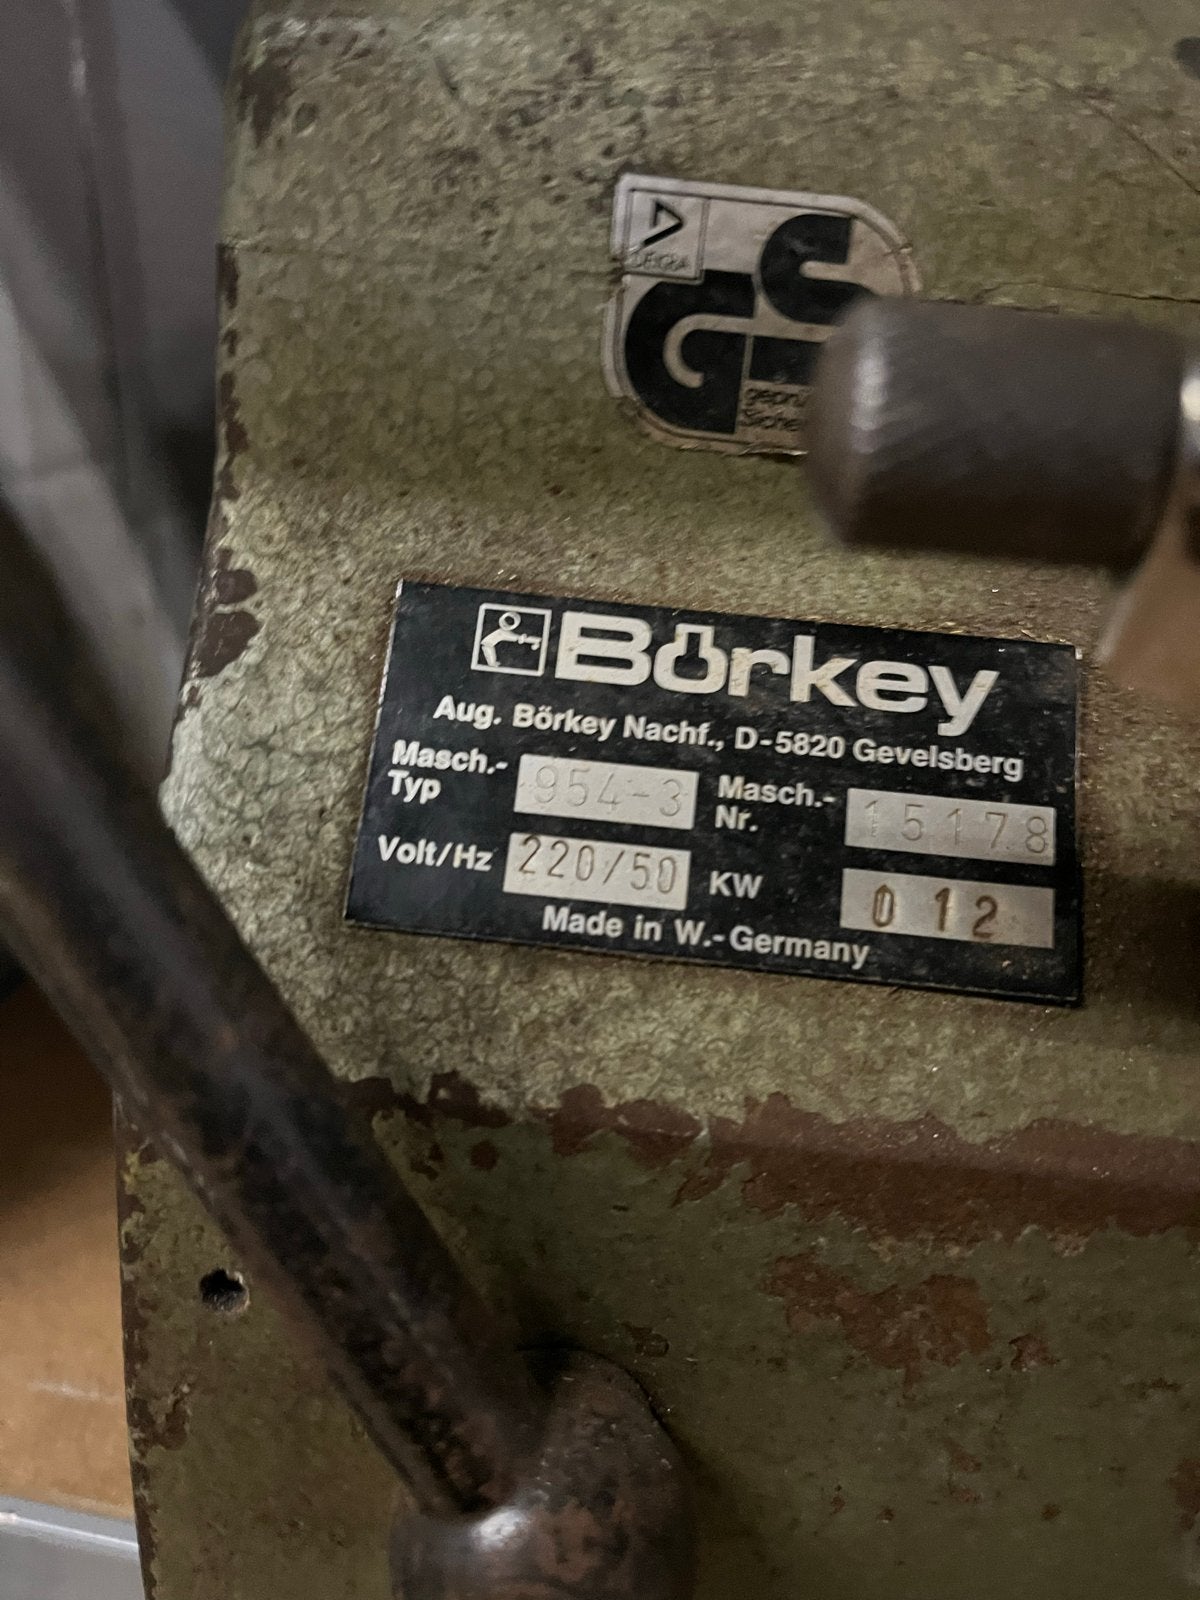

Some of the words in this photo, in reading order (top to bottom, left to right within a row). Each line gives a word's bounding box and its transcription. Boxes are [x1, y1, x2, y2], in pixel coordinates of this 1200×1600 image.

[391, 740, 509, 775] Masch.-
[433, 695, 502, 730] Aug.
[512, 703, 617, 742] Börkey
[623, 714, 725, 752] Nachf.,
[734, 726, 846, 760] D-5820
[852, 740, 1024, 782] Gevelsberg
[387, 769, 442, 804] Typ
[534, 764, 685, 818] 954-3
[717, 774, 837, 808] Masch.-
[714, 805, 759, 832] Nr.
[864, 800, 1049, 855] 15178
[377, 834, 494, 872] Volt/Hz
[518, 833, 679, 895] 220/50
[709, 870, 763, 899] KW
[542, 905, 623, 937] Made
[633, 914, 662, 942] in
[674, 920, 870, 968] W.-Germany
